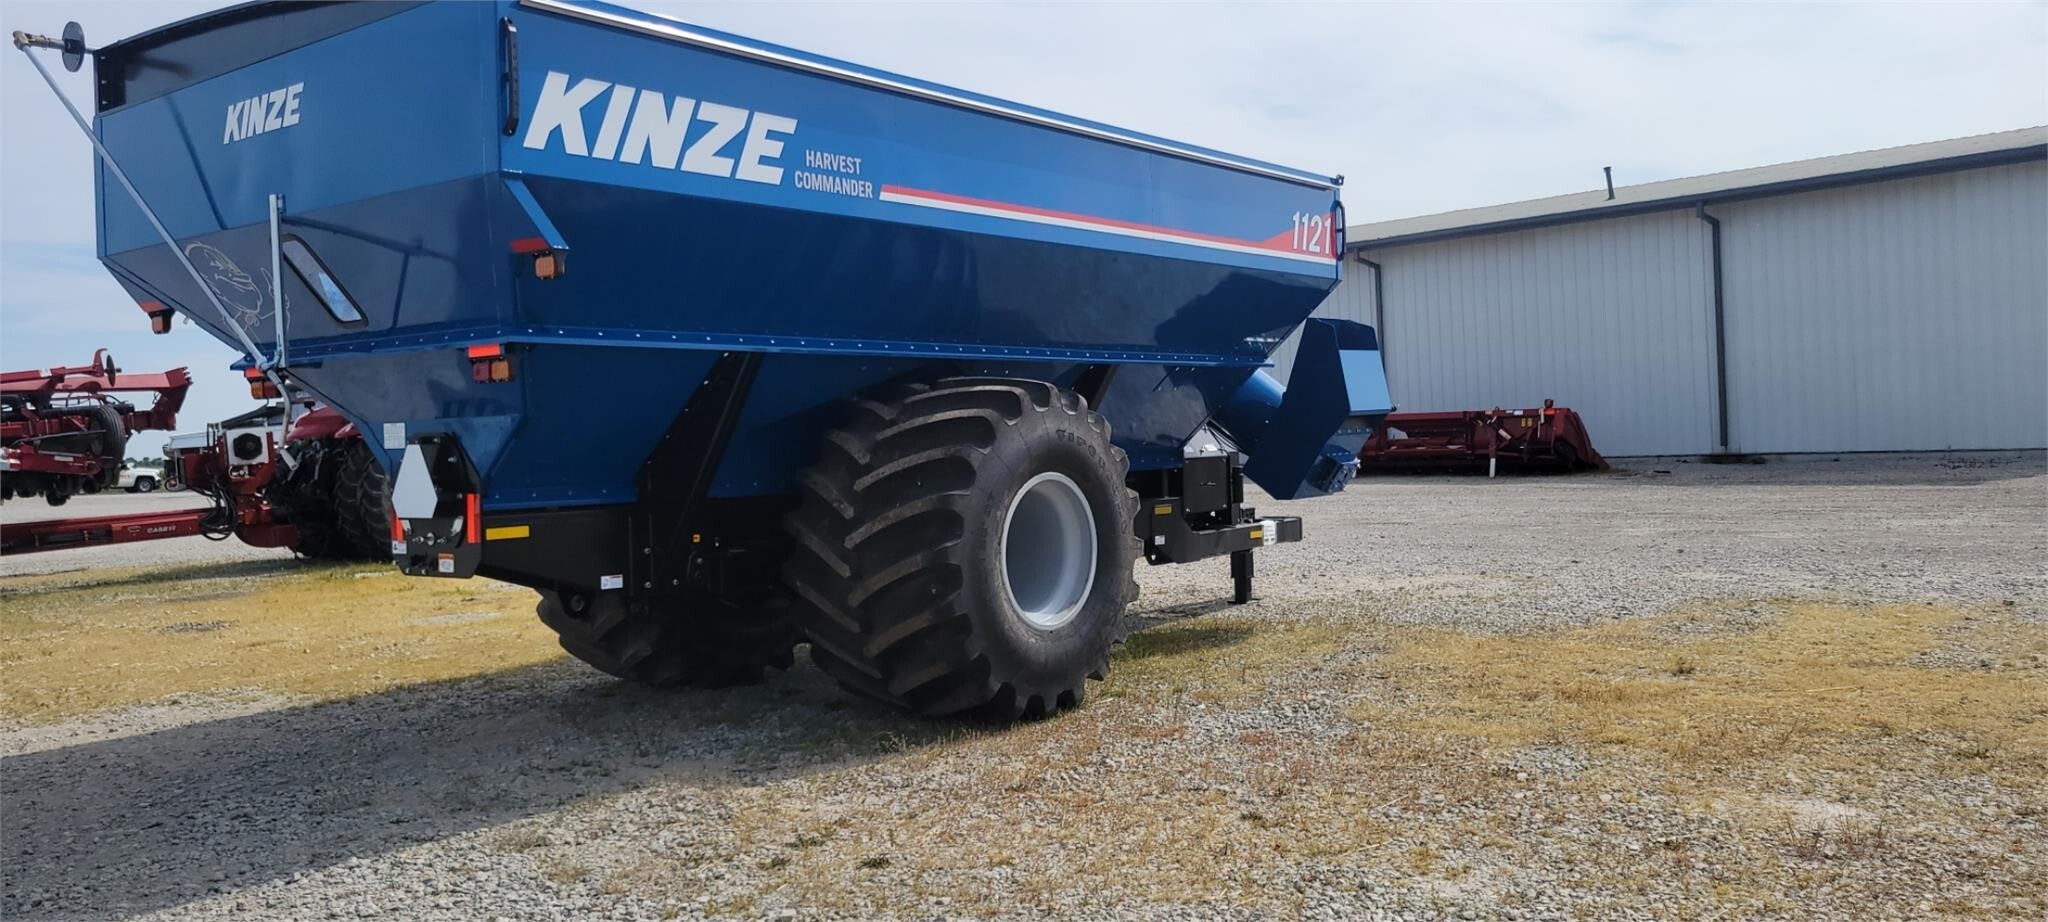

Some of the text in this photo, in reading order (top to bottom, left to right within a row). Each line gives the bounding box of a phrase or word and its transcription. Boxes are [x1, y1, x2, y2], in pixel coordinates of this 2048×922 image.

[222, 82, 305, 145] KINZE
[523, 70, 798, 186] KINZE
[805, 149, 862, 175] HARVEST
[794, 170, 874, 199] COMMANDER
[1292, 210, 1332, 254] 1121
